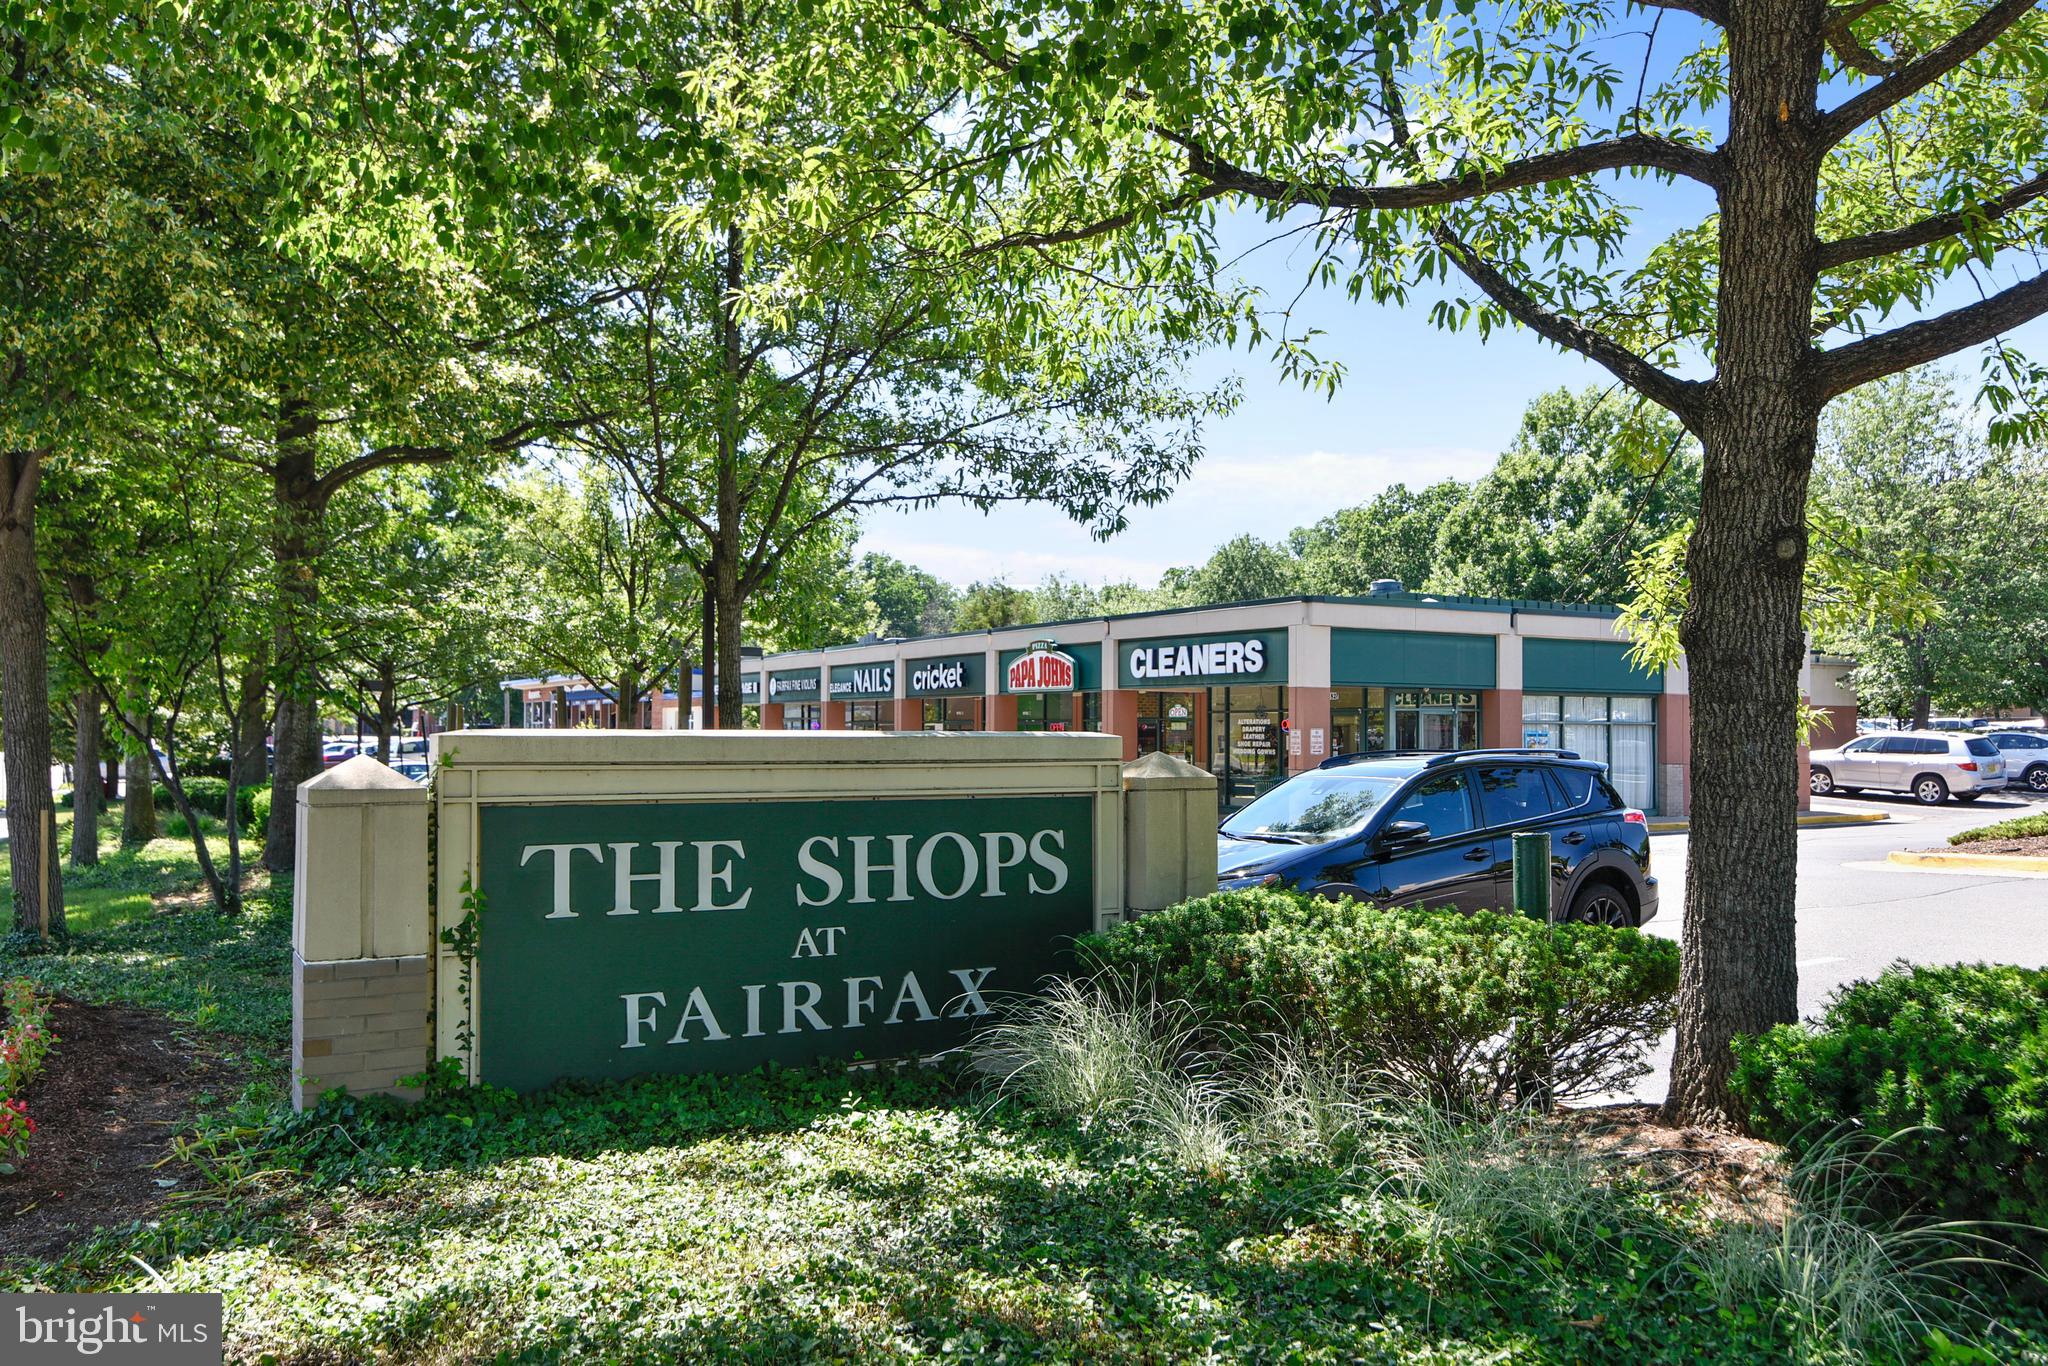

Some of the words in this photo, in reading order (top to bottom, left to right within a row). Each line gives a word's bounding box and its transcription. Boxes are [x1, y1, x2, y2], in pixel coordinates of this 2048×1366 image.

[1031, 642, 1048, 650] PIZZA
[1129, 639, 1264, 679] CLEANERS
[792, 680, 801, 691] FINE
[829, 682, 852, 693] ELEGANCE
[853, 667, 892, 693] NAILS
[913, 662, 963, 690] cricket
[1010, 657, 1036, 688] PAPA
[1037, 655, 1072, 688] JOHNS
[1170, 708, 1187, 717] OPEN
[1395, 692, 1473, 705] CLEANES
[520, 839, 753, 919] THE
[796, 829, 1069, 907] SHOPS
[791, 926, 846, 959] AT
[620, 967, 997, 1049] FAIRFAX
